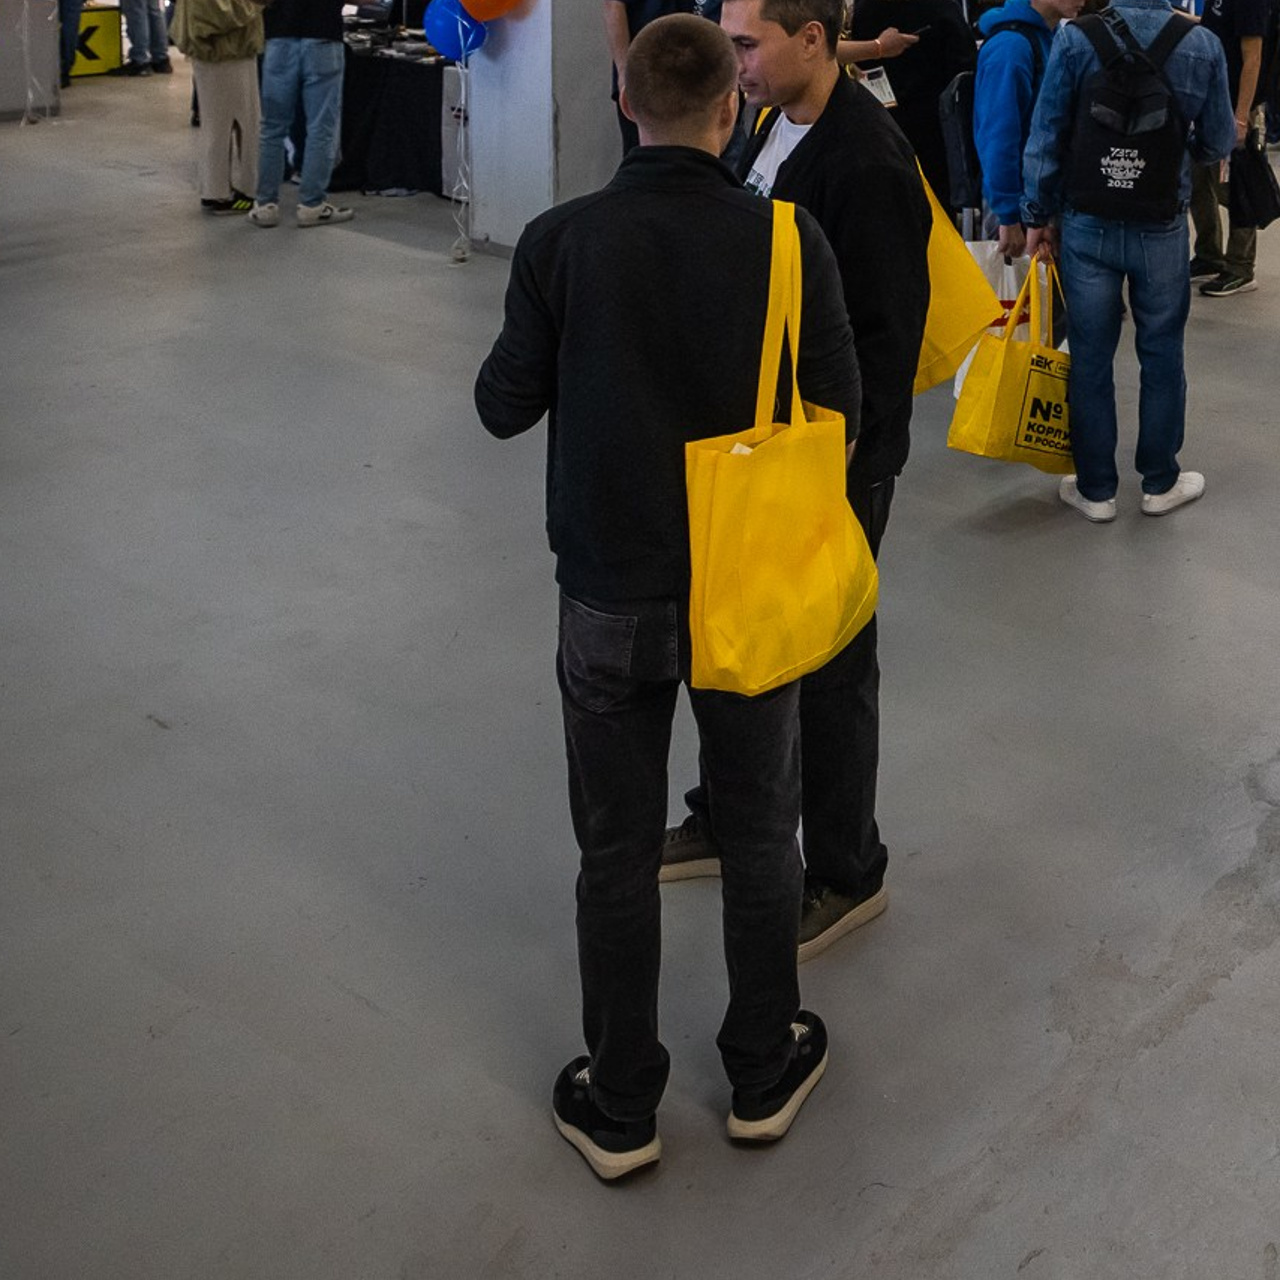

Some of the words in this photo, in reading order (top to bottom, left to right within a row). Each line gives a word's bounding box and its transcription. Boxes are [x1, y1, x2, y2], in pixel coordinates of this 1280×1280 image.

[1107, 179, 1134, 189] 2022
[1026, 421, 1071, 441] КОРПУ
[1034, 436, 1072, 451] РОССИ
